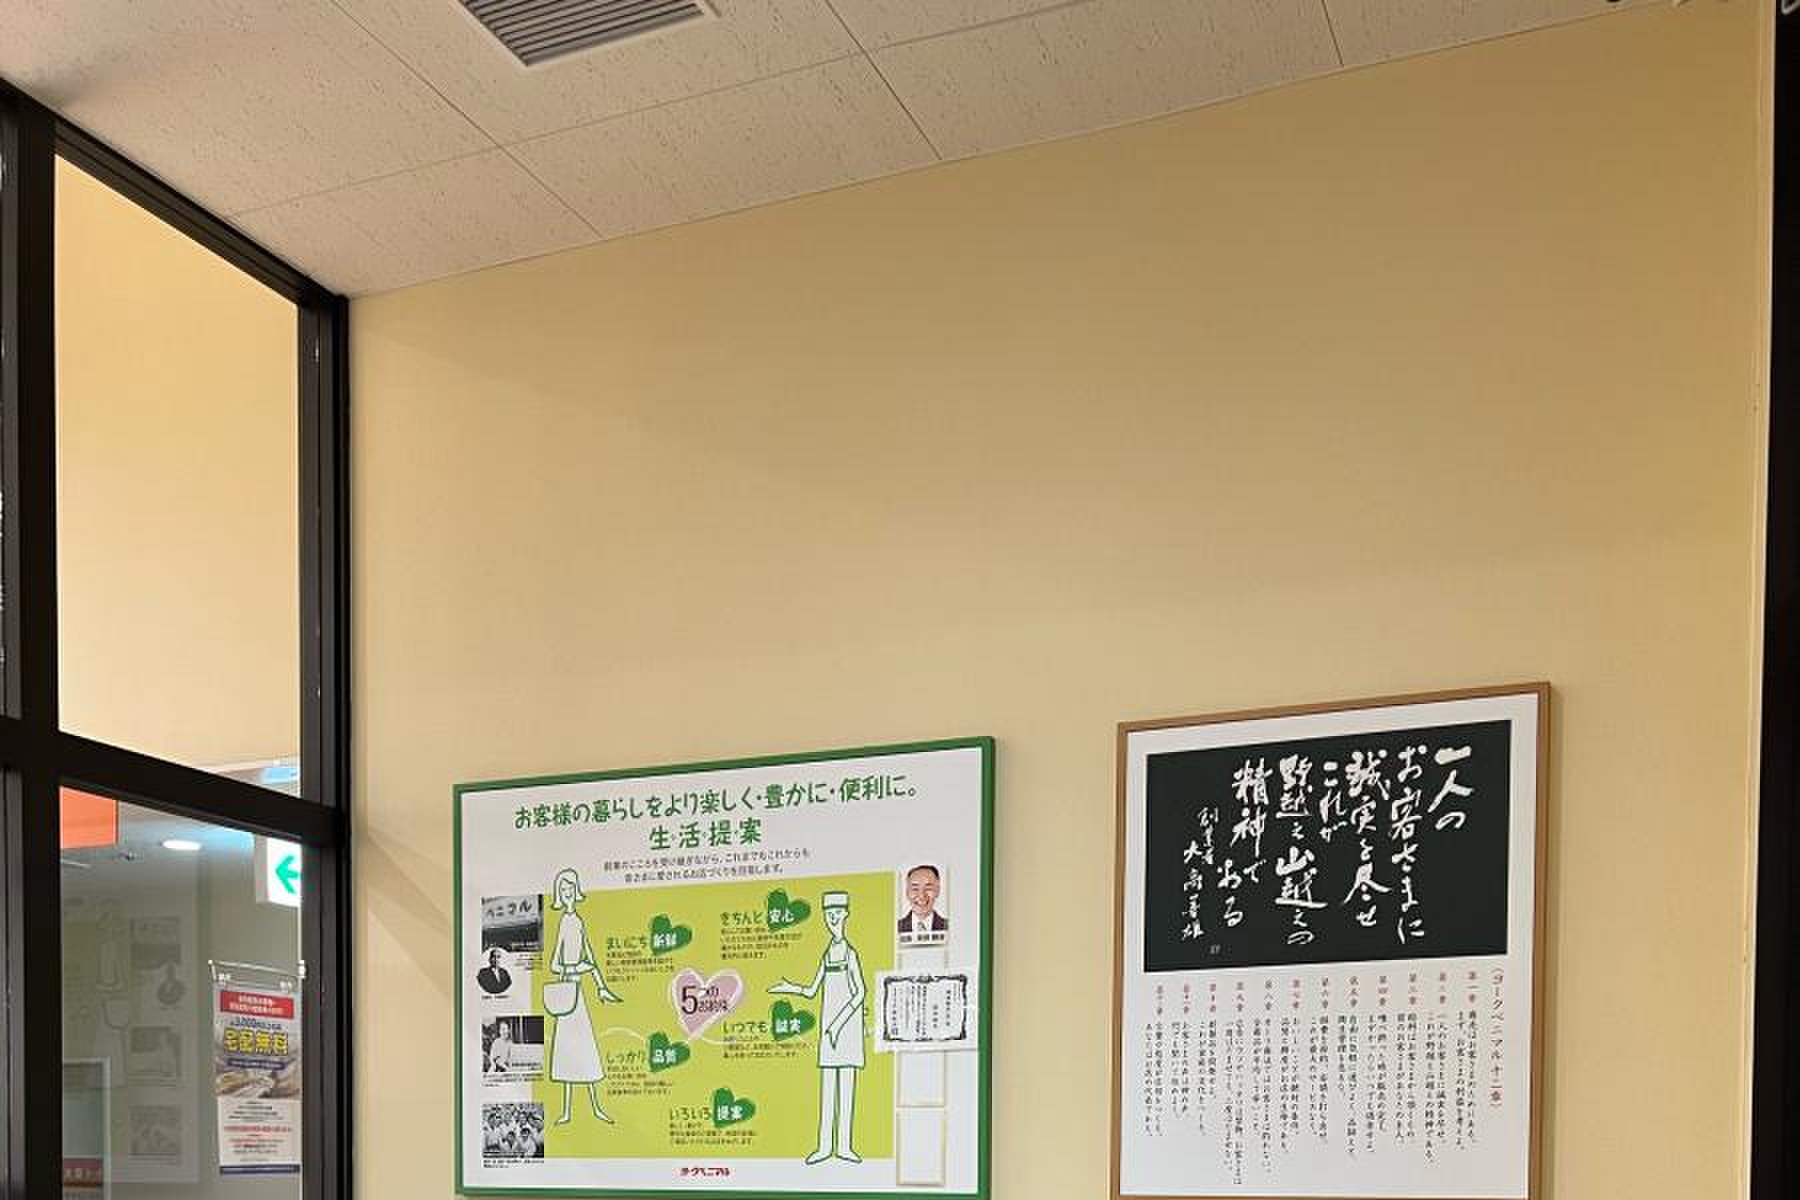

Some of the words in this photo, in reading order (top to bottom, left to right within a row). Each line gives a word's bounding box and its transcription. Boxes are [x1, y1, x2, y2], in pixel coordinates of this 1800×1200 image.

[1319, 761, 1349, 842] これが
[1427, 746, 1474, 831] 一人の
[1388, 744, 1427, 945] お客さまに
